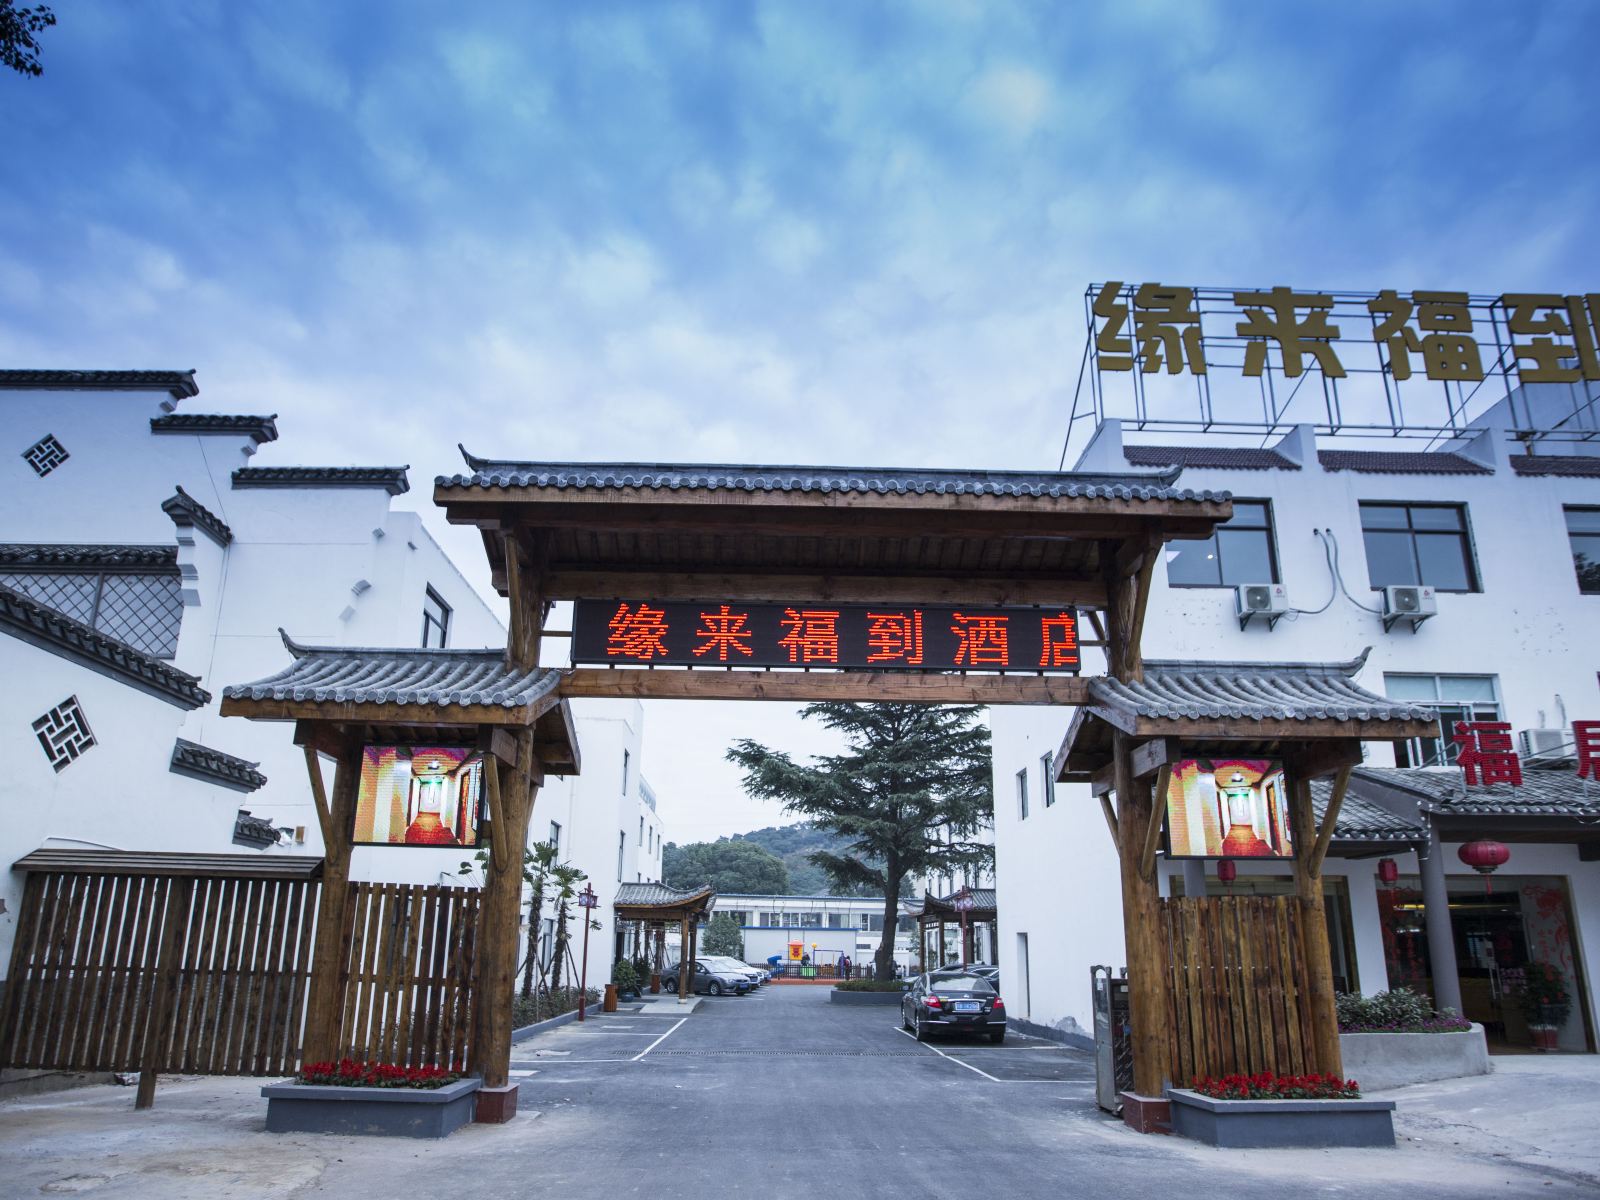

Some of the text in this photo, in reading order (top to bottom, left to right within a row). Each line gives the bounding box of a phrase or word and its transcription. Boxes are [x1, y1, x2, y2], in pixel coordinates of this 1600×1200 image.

[1093, 281, 1600, 384] 缘来福到
[606, 602, 1078, 667] 缘来福到酒店
